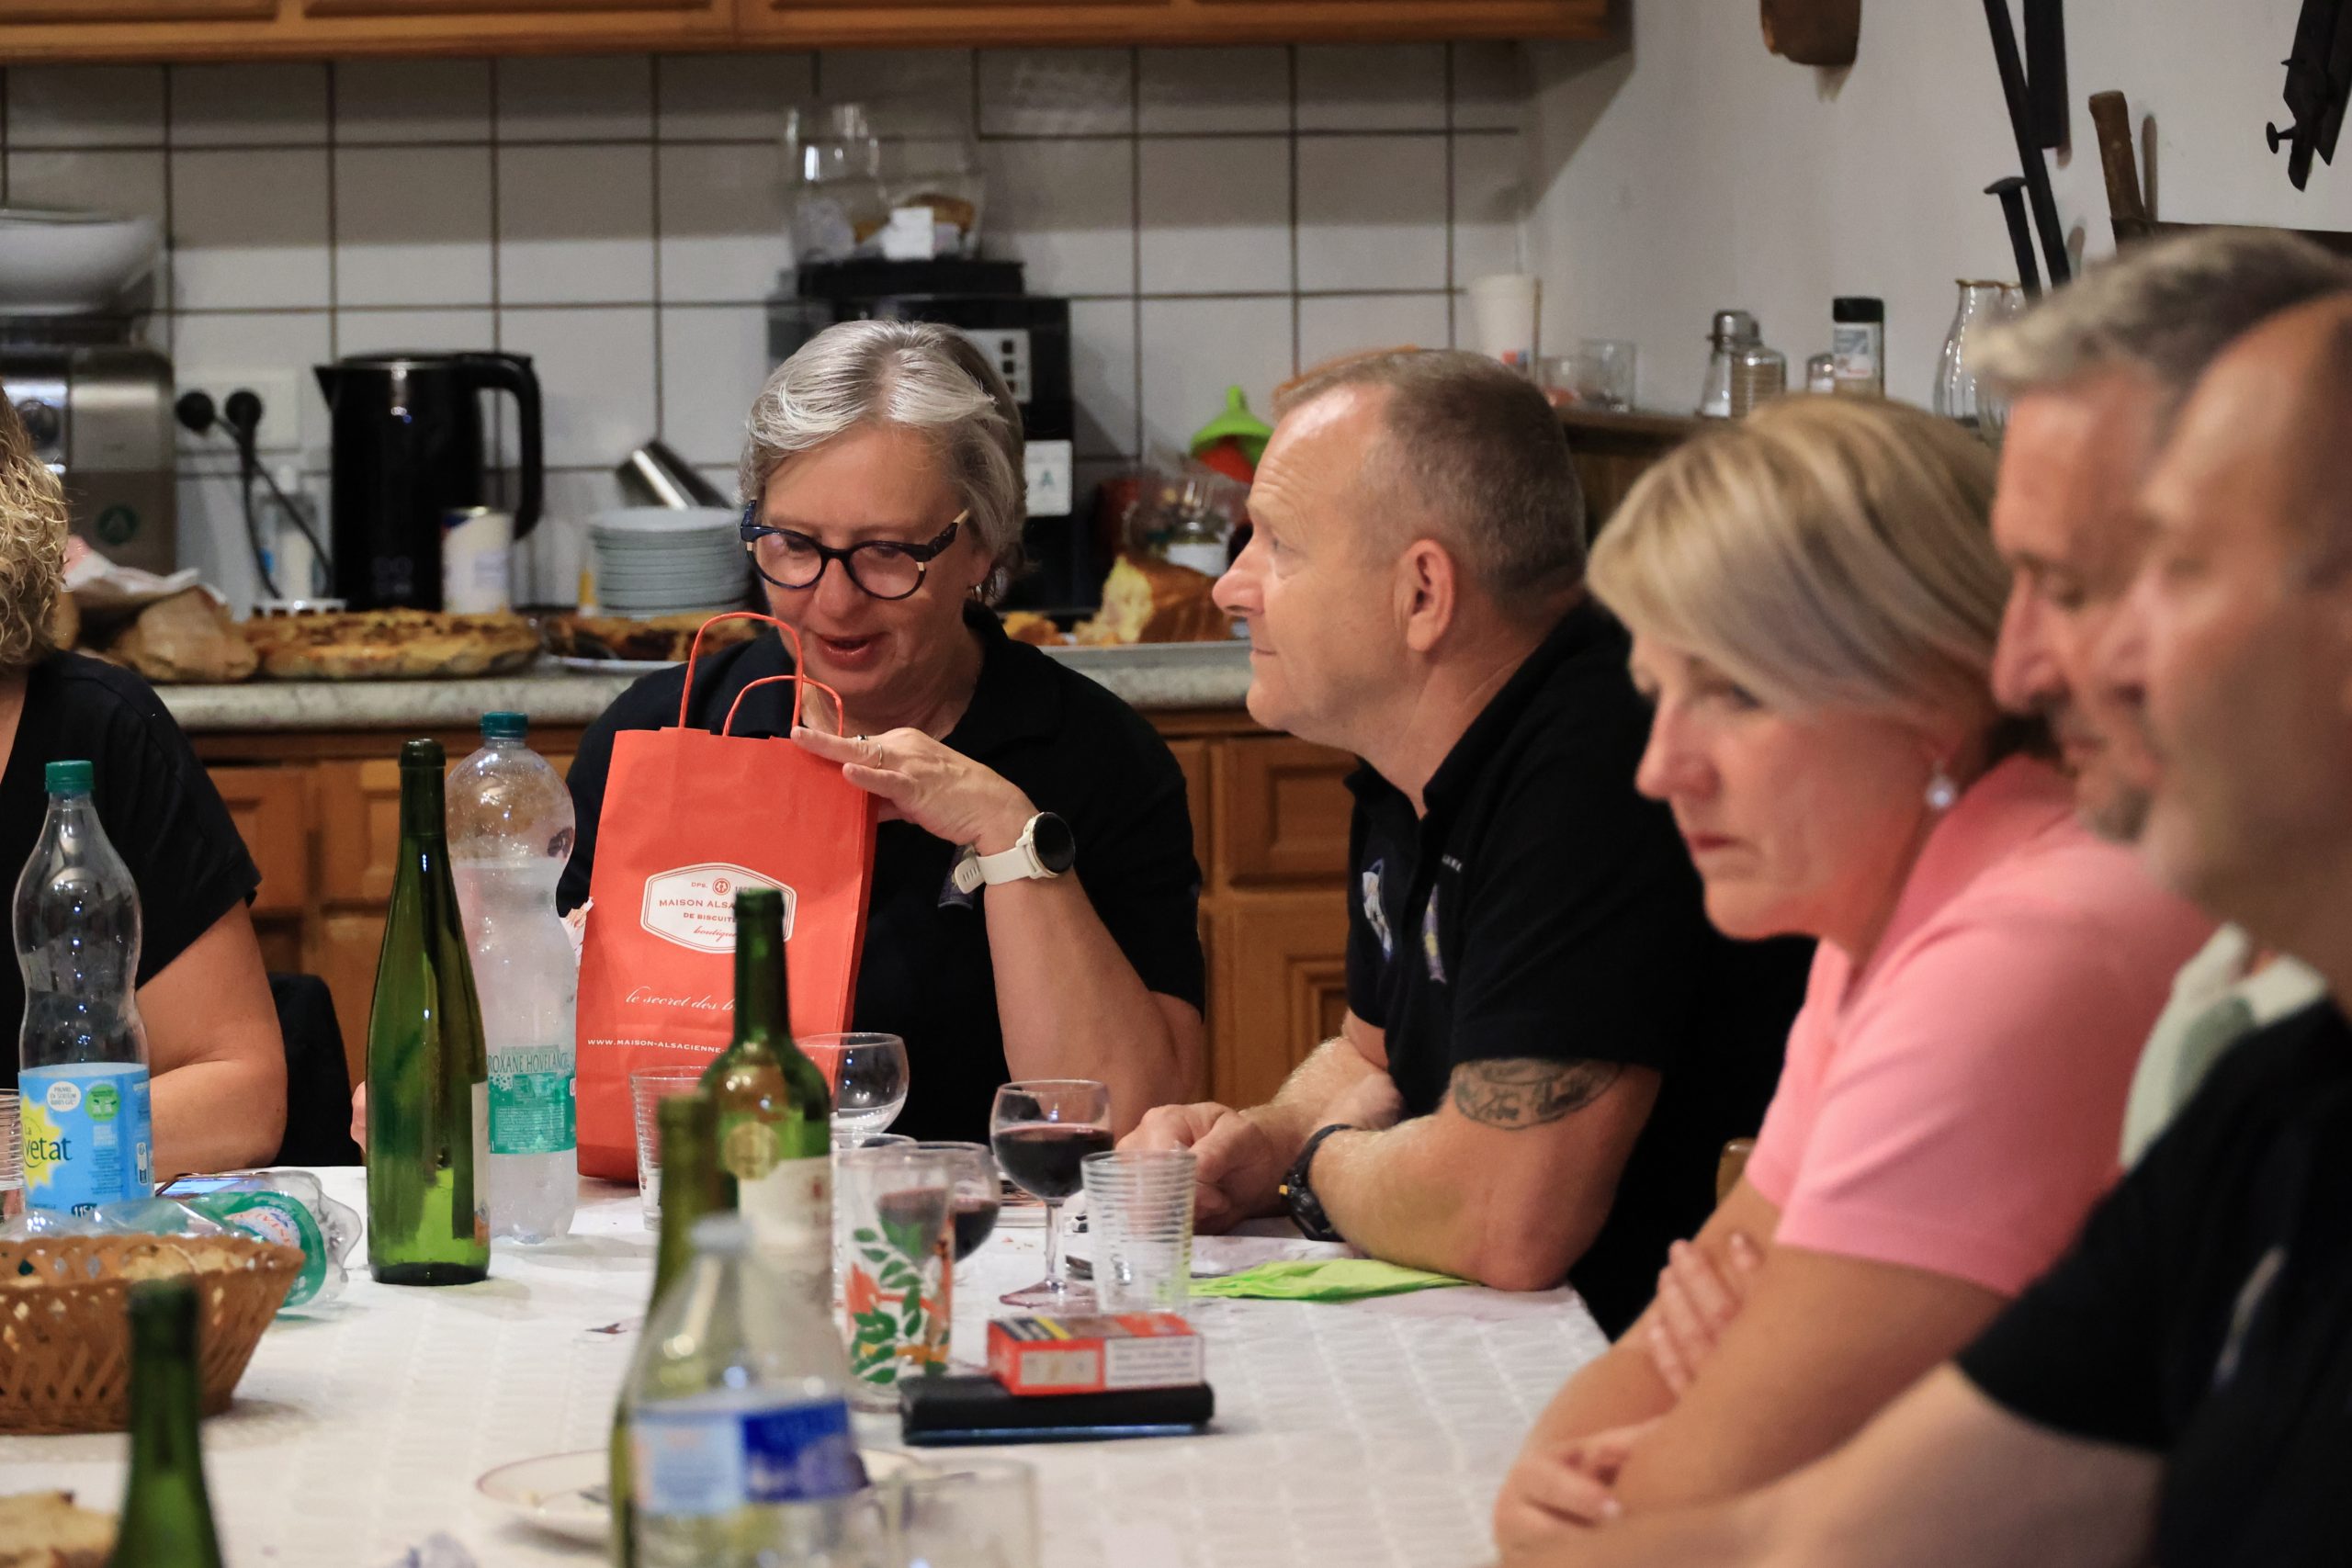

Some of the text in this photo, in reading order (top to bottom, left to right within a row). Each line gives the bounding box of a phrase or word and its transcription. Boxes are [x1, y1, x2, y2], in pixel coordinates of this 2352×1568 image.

[659, 899, 704, 908] MAISON
[626, 986, 651, 1003] le
[643, 997, 691, 1007] secret
[691, 995, 718, 1010] des
